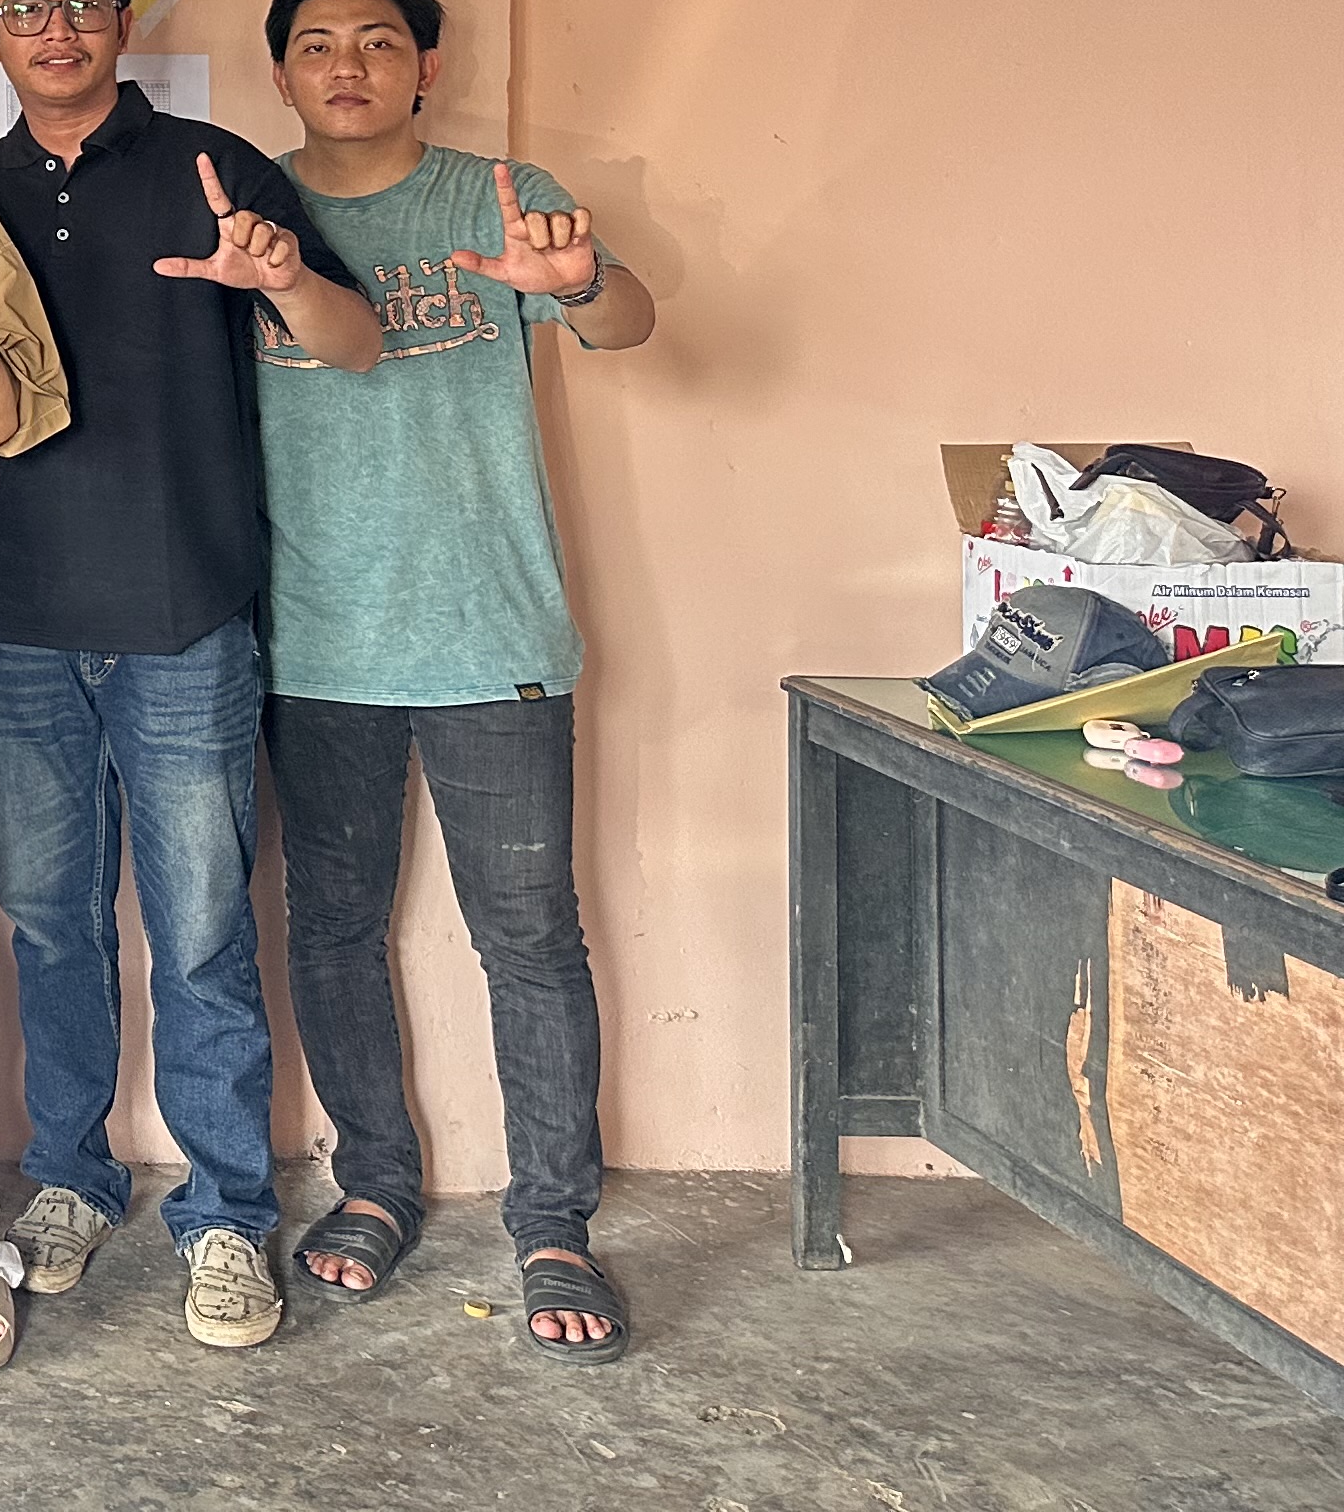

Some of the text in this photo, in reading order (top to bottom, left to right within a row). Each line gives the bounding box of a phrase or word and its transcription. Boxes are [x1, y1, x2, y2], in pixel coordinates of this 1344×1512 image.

[1152, 585, 1310, 598] Air Minum Dalam Kemasan
